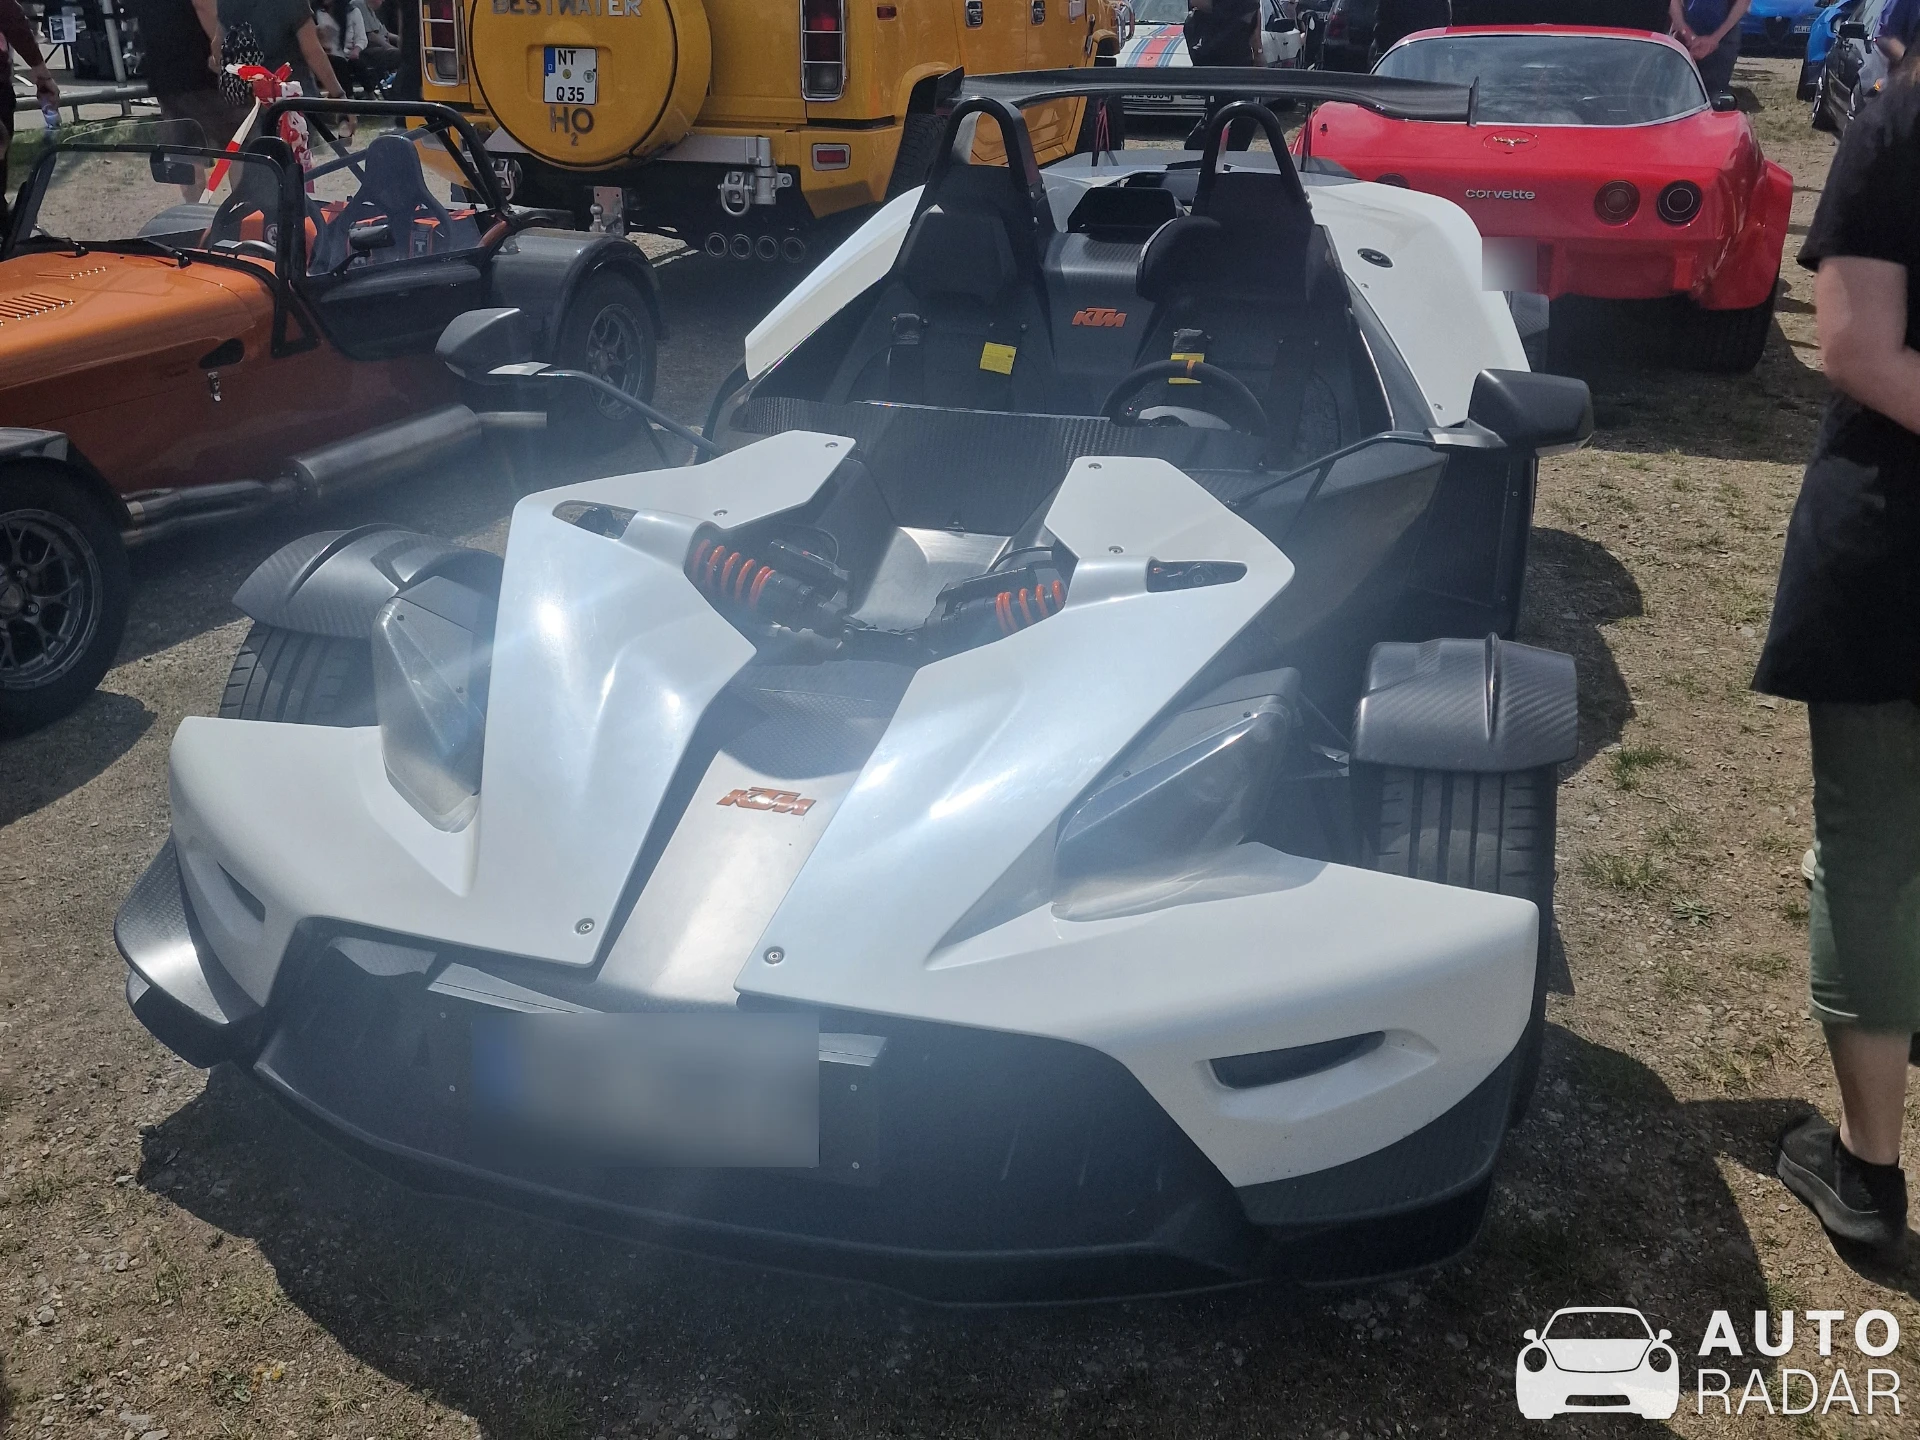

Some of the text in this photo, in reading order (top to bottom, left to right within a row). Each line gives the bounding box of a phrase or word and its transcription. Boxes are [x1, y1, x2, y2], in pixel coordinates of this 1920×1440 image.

[492, 0, 642, 17] BESTWATER
[557, 49, 577, 66] NT
[556, 86, 585, 102] Q 35
[1465, 189, 1536, 200] corvette
[1071, 307, 1128, 328] KTM
[716, 786, 817, 817] KTM
